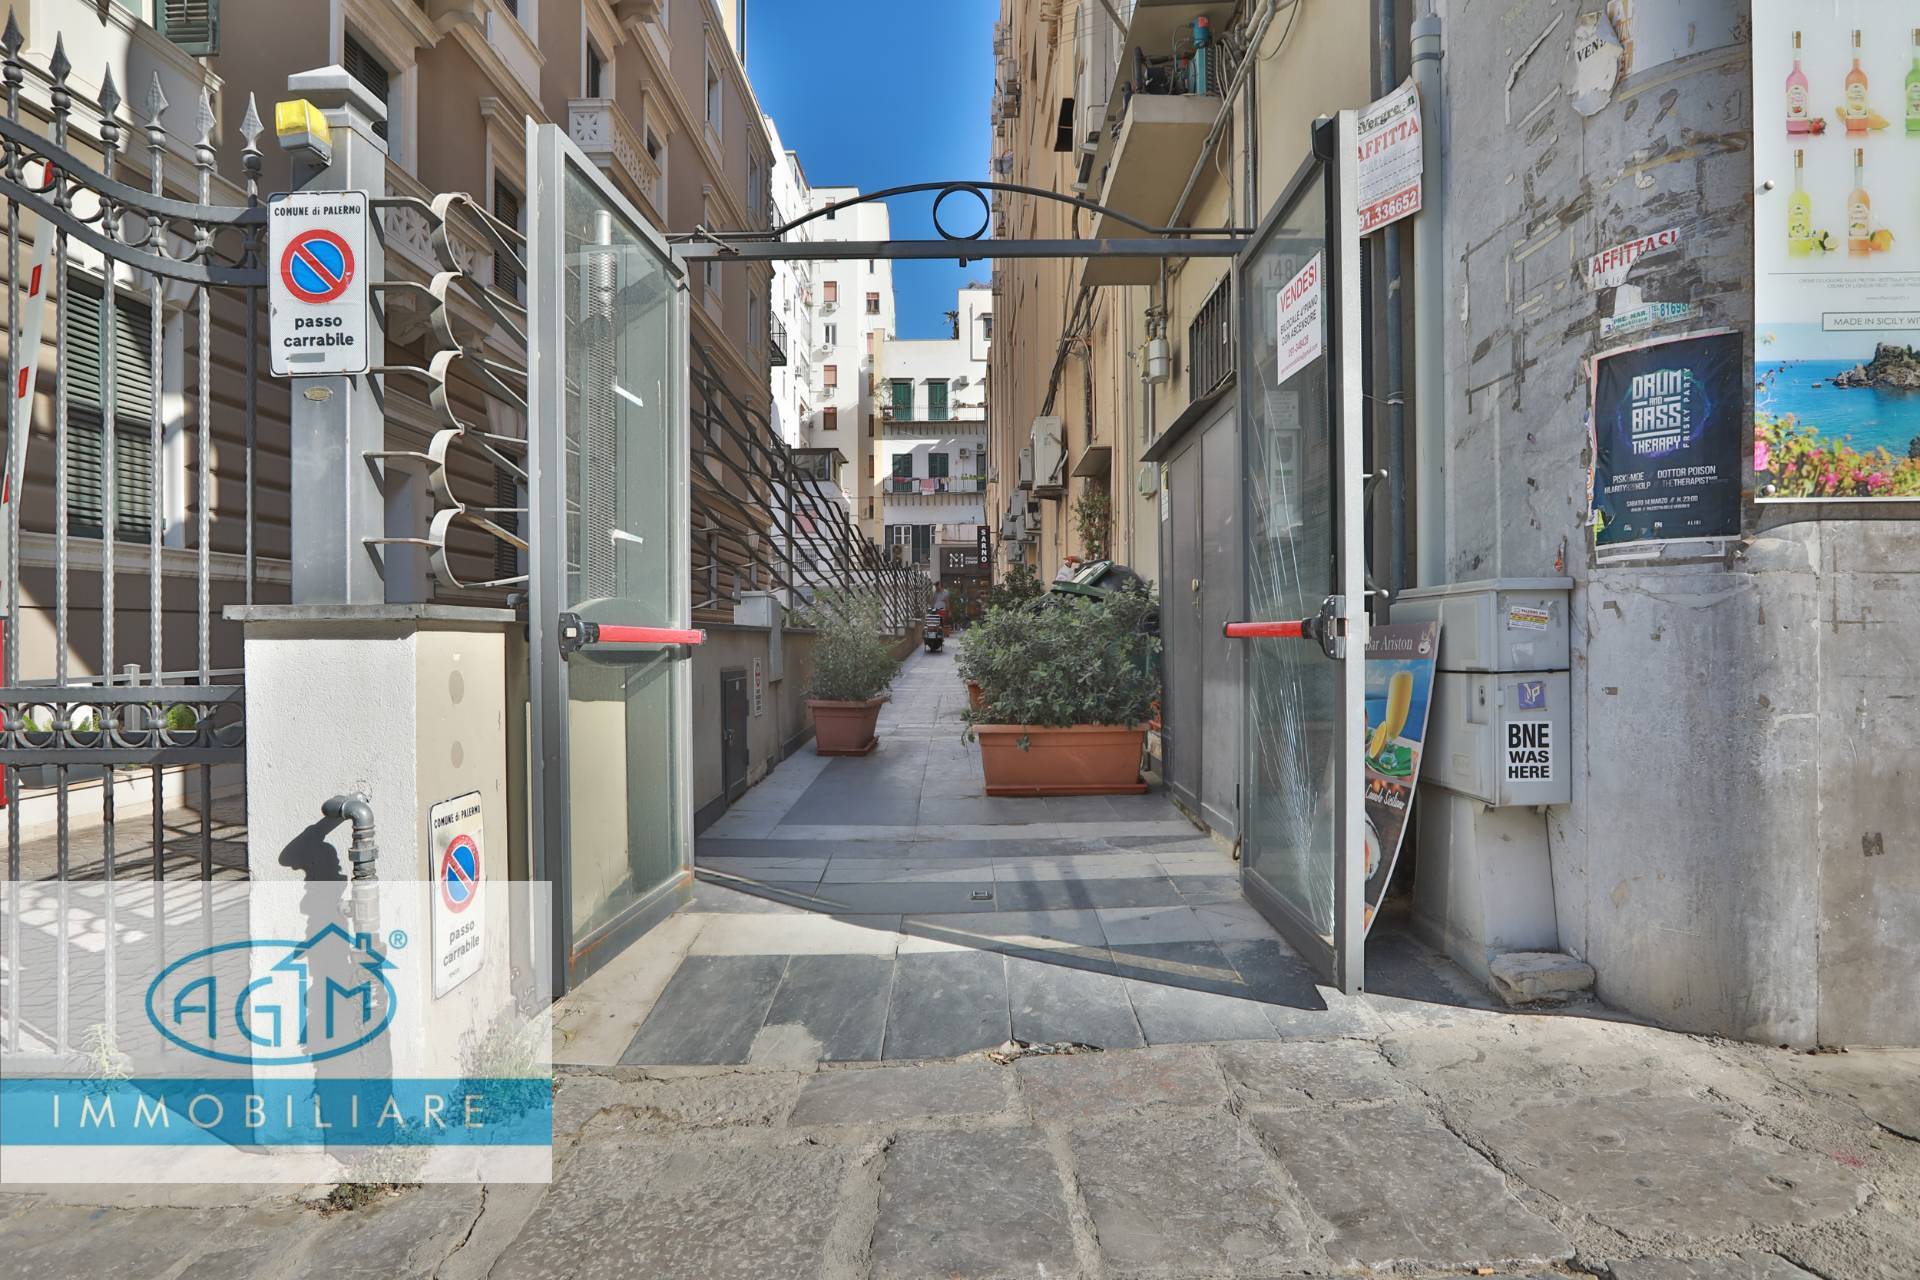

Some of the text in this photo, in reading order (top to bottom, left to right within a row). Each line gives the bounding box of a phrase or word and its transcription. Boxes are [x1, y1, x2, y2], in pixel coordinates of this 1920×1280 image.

[1358, 116, 1419, 162] AFFITTA
[274, 205, 361, 217] COMUNE di PALERMO
[1280, 261, 1317, 312] VENDESI
[294, 316, 342, 330] passo
[1833, 318, 1862, 326] MADE
[1877, 317, 1904, 325] SICILY
[283, 333, 354, 347] carrabile
[1632, 369, 1681, 400] DRUM
[1632, 402, 1681, 432] BASS
[1632, 435, 1681, 455] THERAPY
[1657, 465, 1716, 479] DOTTOR POISON
[1626, 499, 1644, 507] SABATO
[1650, 497, 1668, 505] MARZO
[1381, 634, 1413, 650] Ariston
[1508, 724, 1549, 748] BNE
[1509, 751, 1549, 763] WAS
[1508, 766, 1550, 779] HERE
[434, 804, 481, 829] COMUNE di PALERMO
[450, 919, 475, 945] passo
[443, 935, 480, 967] carrabile
